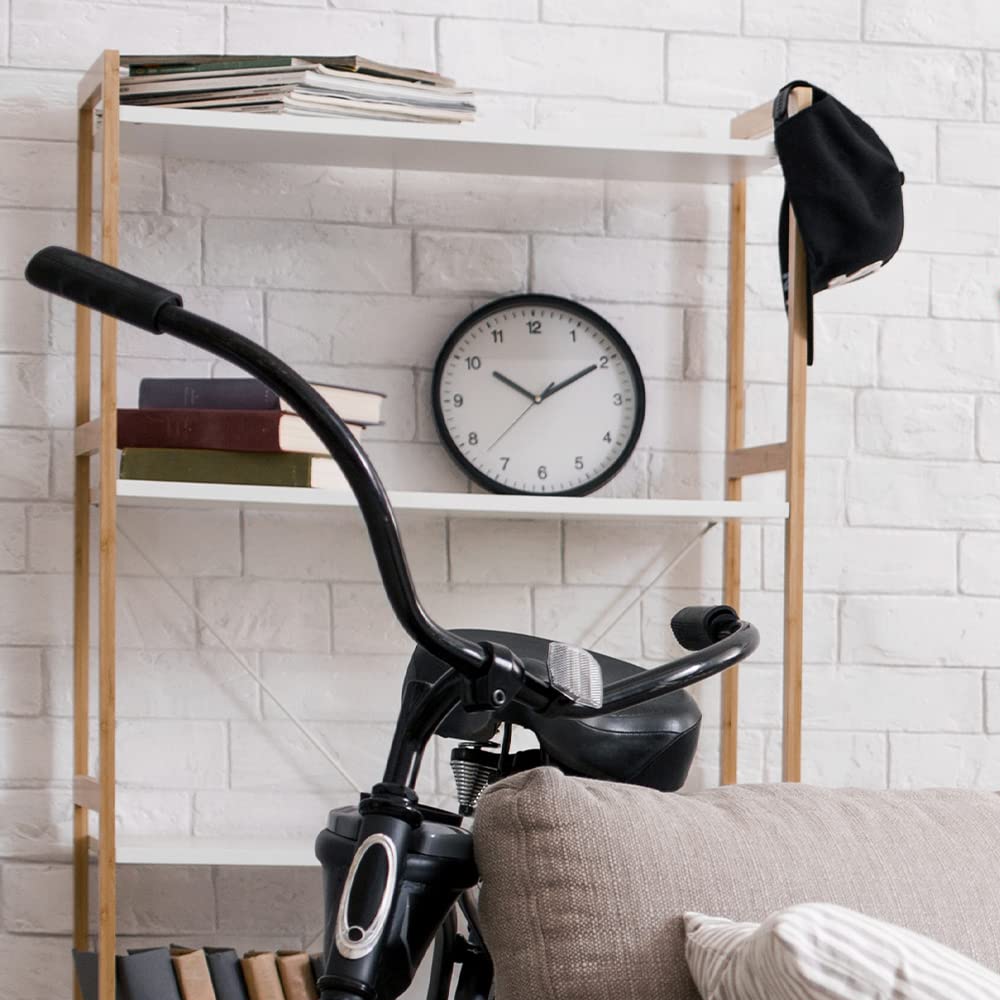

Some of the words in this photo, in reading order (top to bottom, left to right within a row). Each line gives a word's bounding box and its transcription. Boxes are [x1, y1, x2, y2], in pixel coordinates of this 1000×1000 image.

[525, 320, 543, 335] 12
[491, 329, 504, 344] 11
[569, 329, 577, 343] 1
[465, 355, 482, 370] 10
[599, 356, 609, 370] 2
[453, 393, 464, 408] 9
[613, 393, 623, 407] 3
[468, 432, 479, 446] 8
[602, 431, 612, 444] 4
[500, 457, 510, 471] 7
[574, 456, 584, 470] 5
[537, 465, 548, 480] 6
